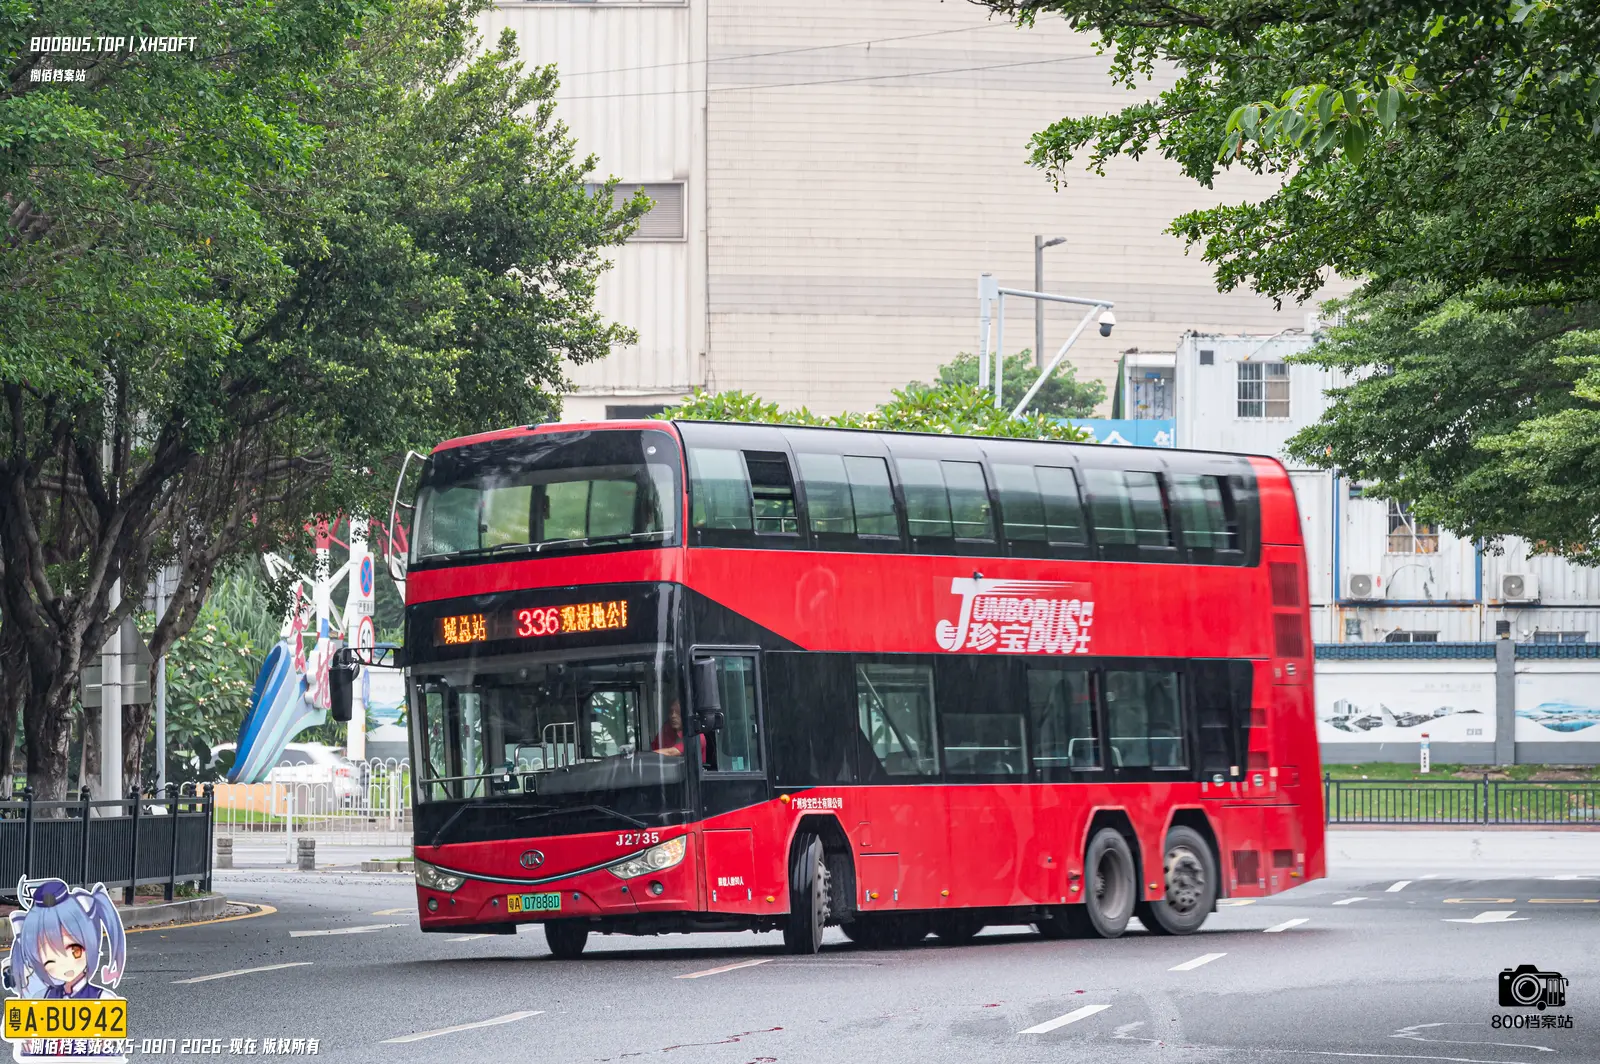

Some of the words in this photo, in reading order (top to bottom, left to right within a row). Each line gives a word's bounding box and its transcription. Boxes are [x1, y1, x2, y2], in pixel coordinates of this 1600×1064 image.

[518, 607, 560, 637] 336
[791, 797, 843, 810] 广州珍宝巴士有限公司
[615, 832, 660, 847] J2735
